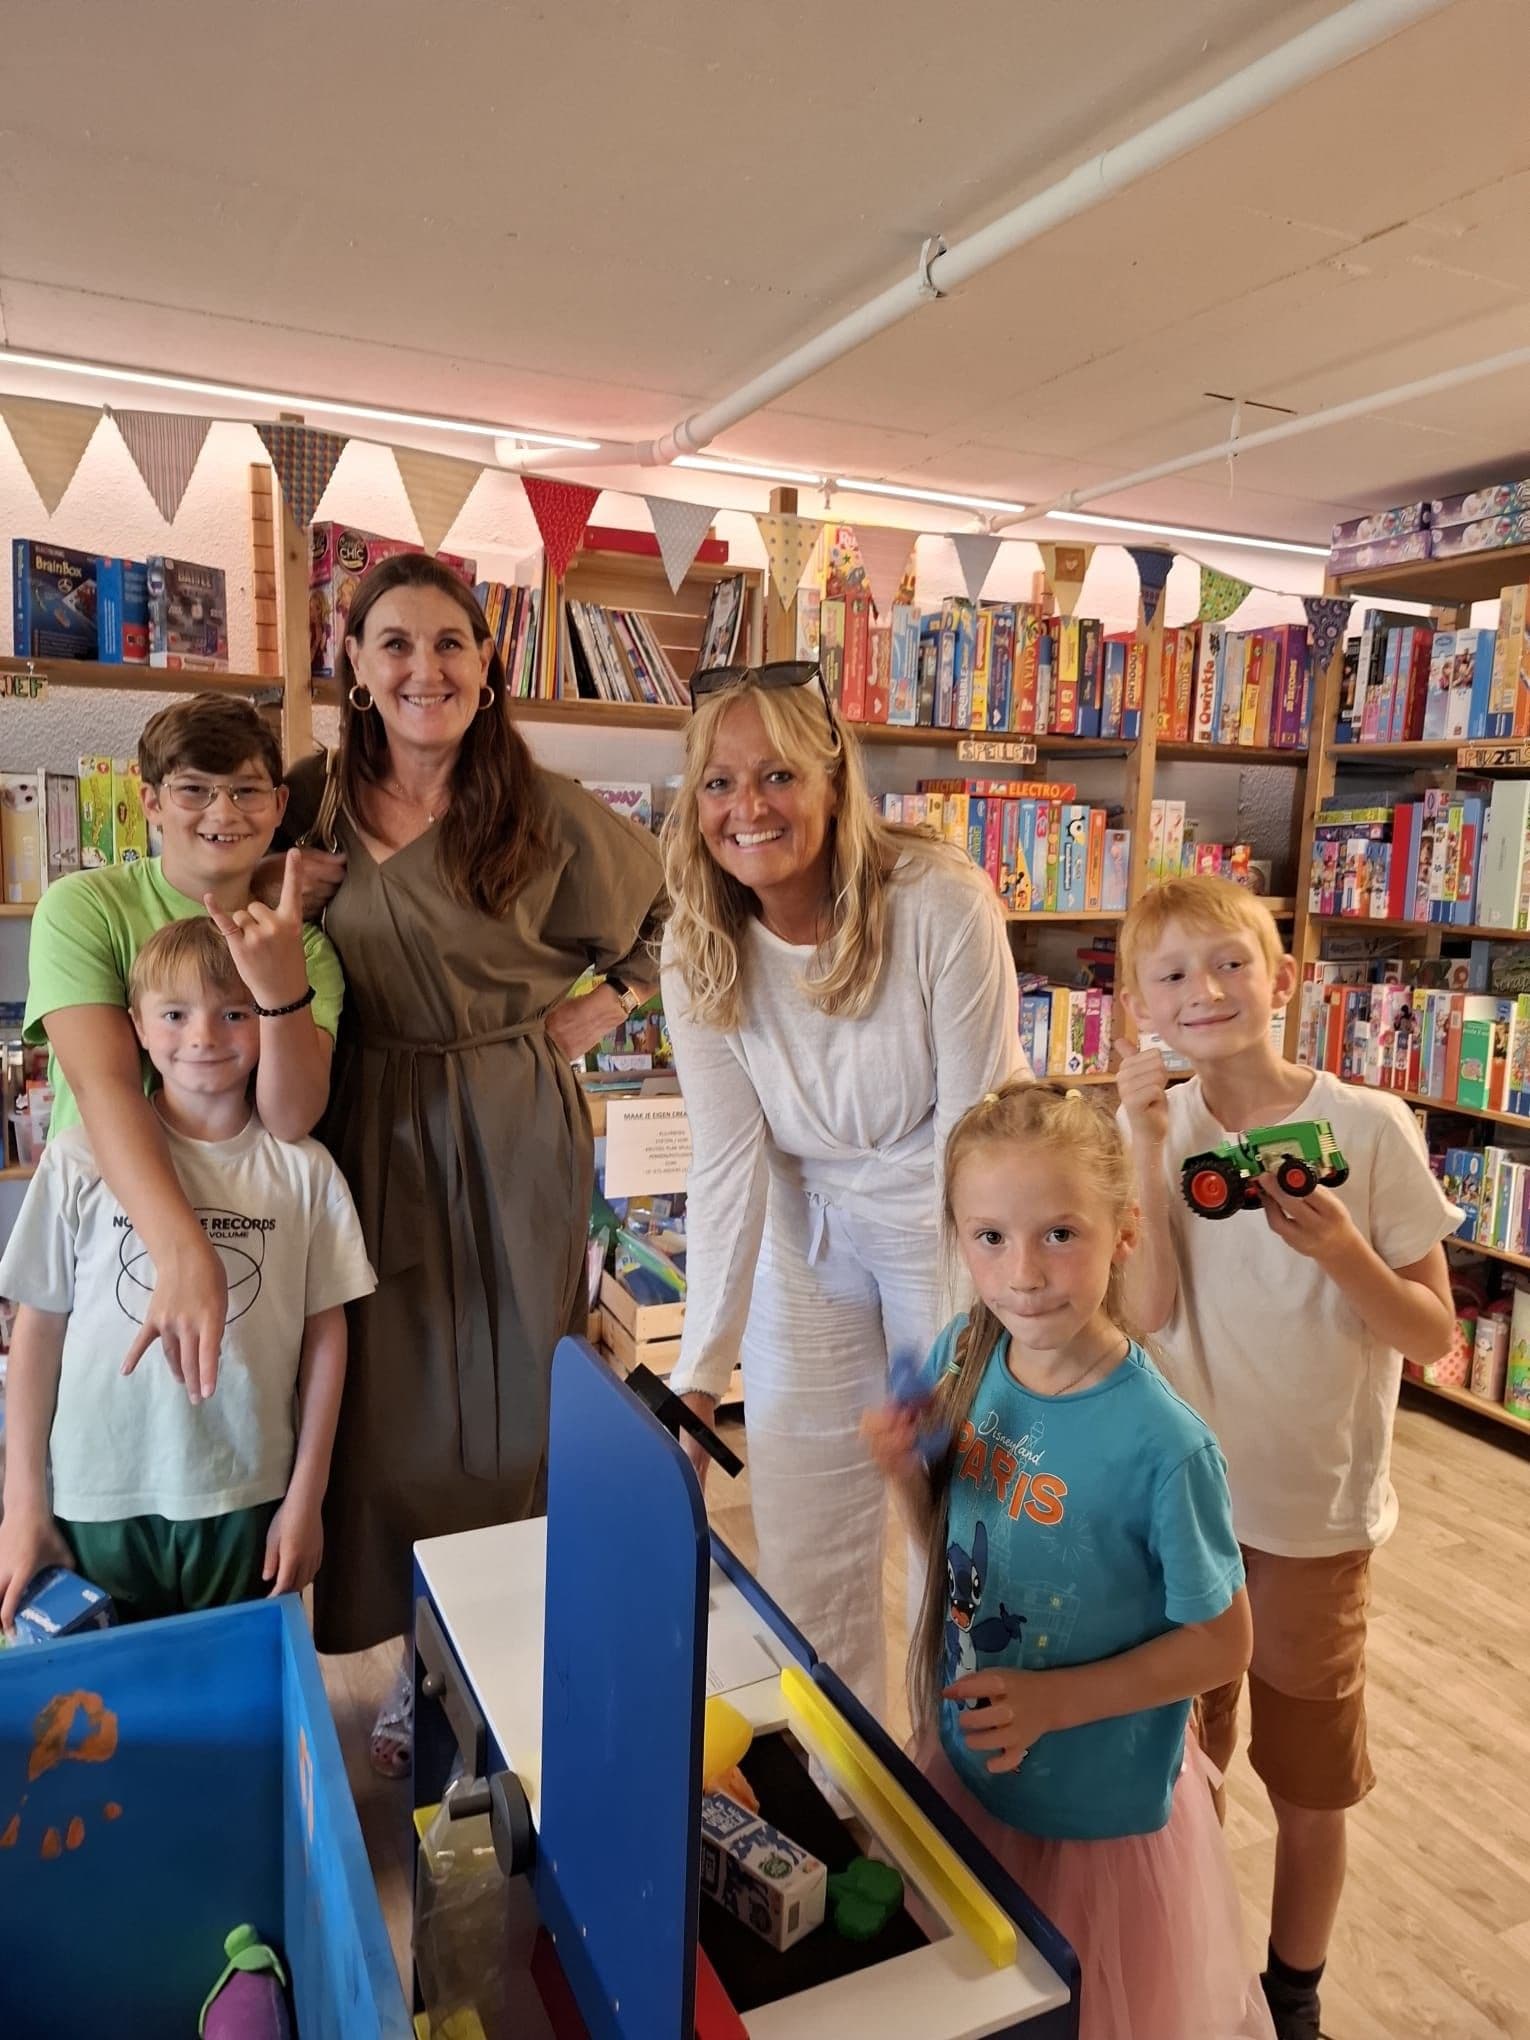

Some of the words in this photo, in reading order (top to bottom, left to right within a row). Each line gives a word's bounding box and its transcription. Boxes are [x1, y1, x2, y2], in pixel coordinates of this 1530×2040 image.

[35, 554, 82, 577] BrainBox
[340, 547, 365, 560] CHIC
[1023, 645, 1035, 689] CATAN
[1127, 653, 1138, 706] DOOLHOF
[958, 669, 970, 726] SCRABBLE
[1200, 660, 1215, 725] Qwirkle
[1009, 783, 1060, 797] ELECTRO
[624, 1112, 642, 1120] MAAK
[209, 1231, 249, 1239] VOLUME
[212, 1218, 276, 1230] RECORDS
[978, 1410, 1045, 1466] Disneyland
[957, 1420, 1068, 1525] PARIS
